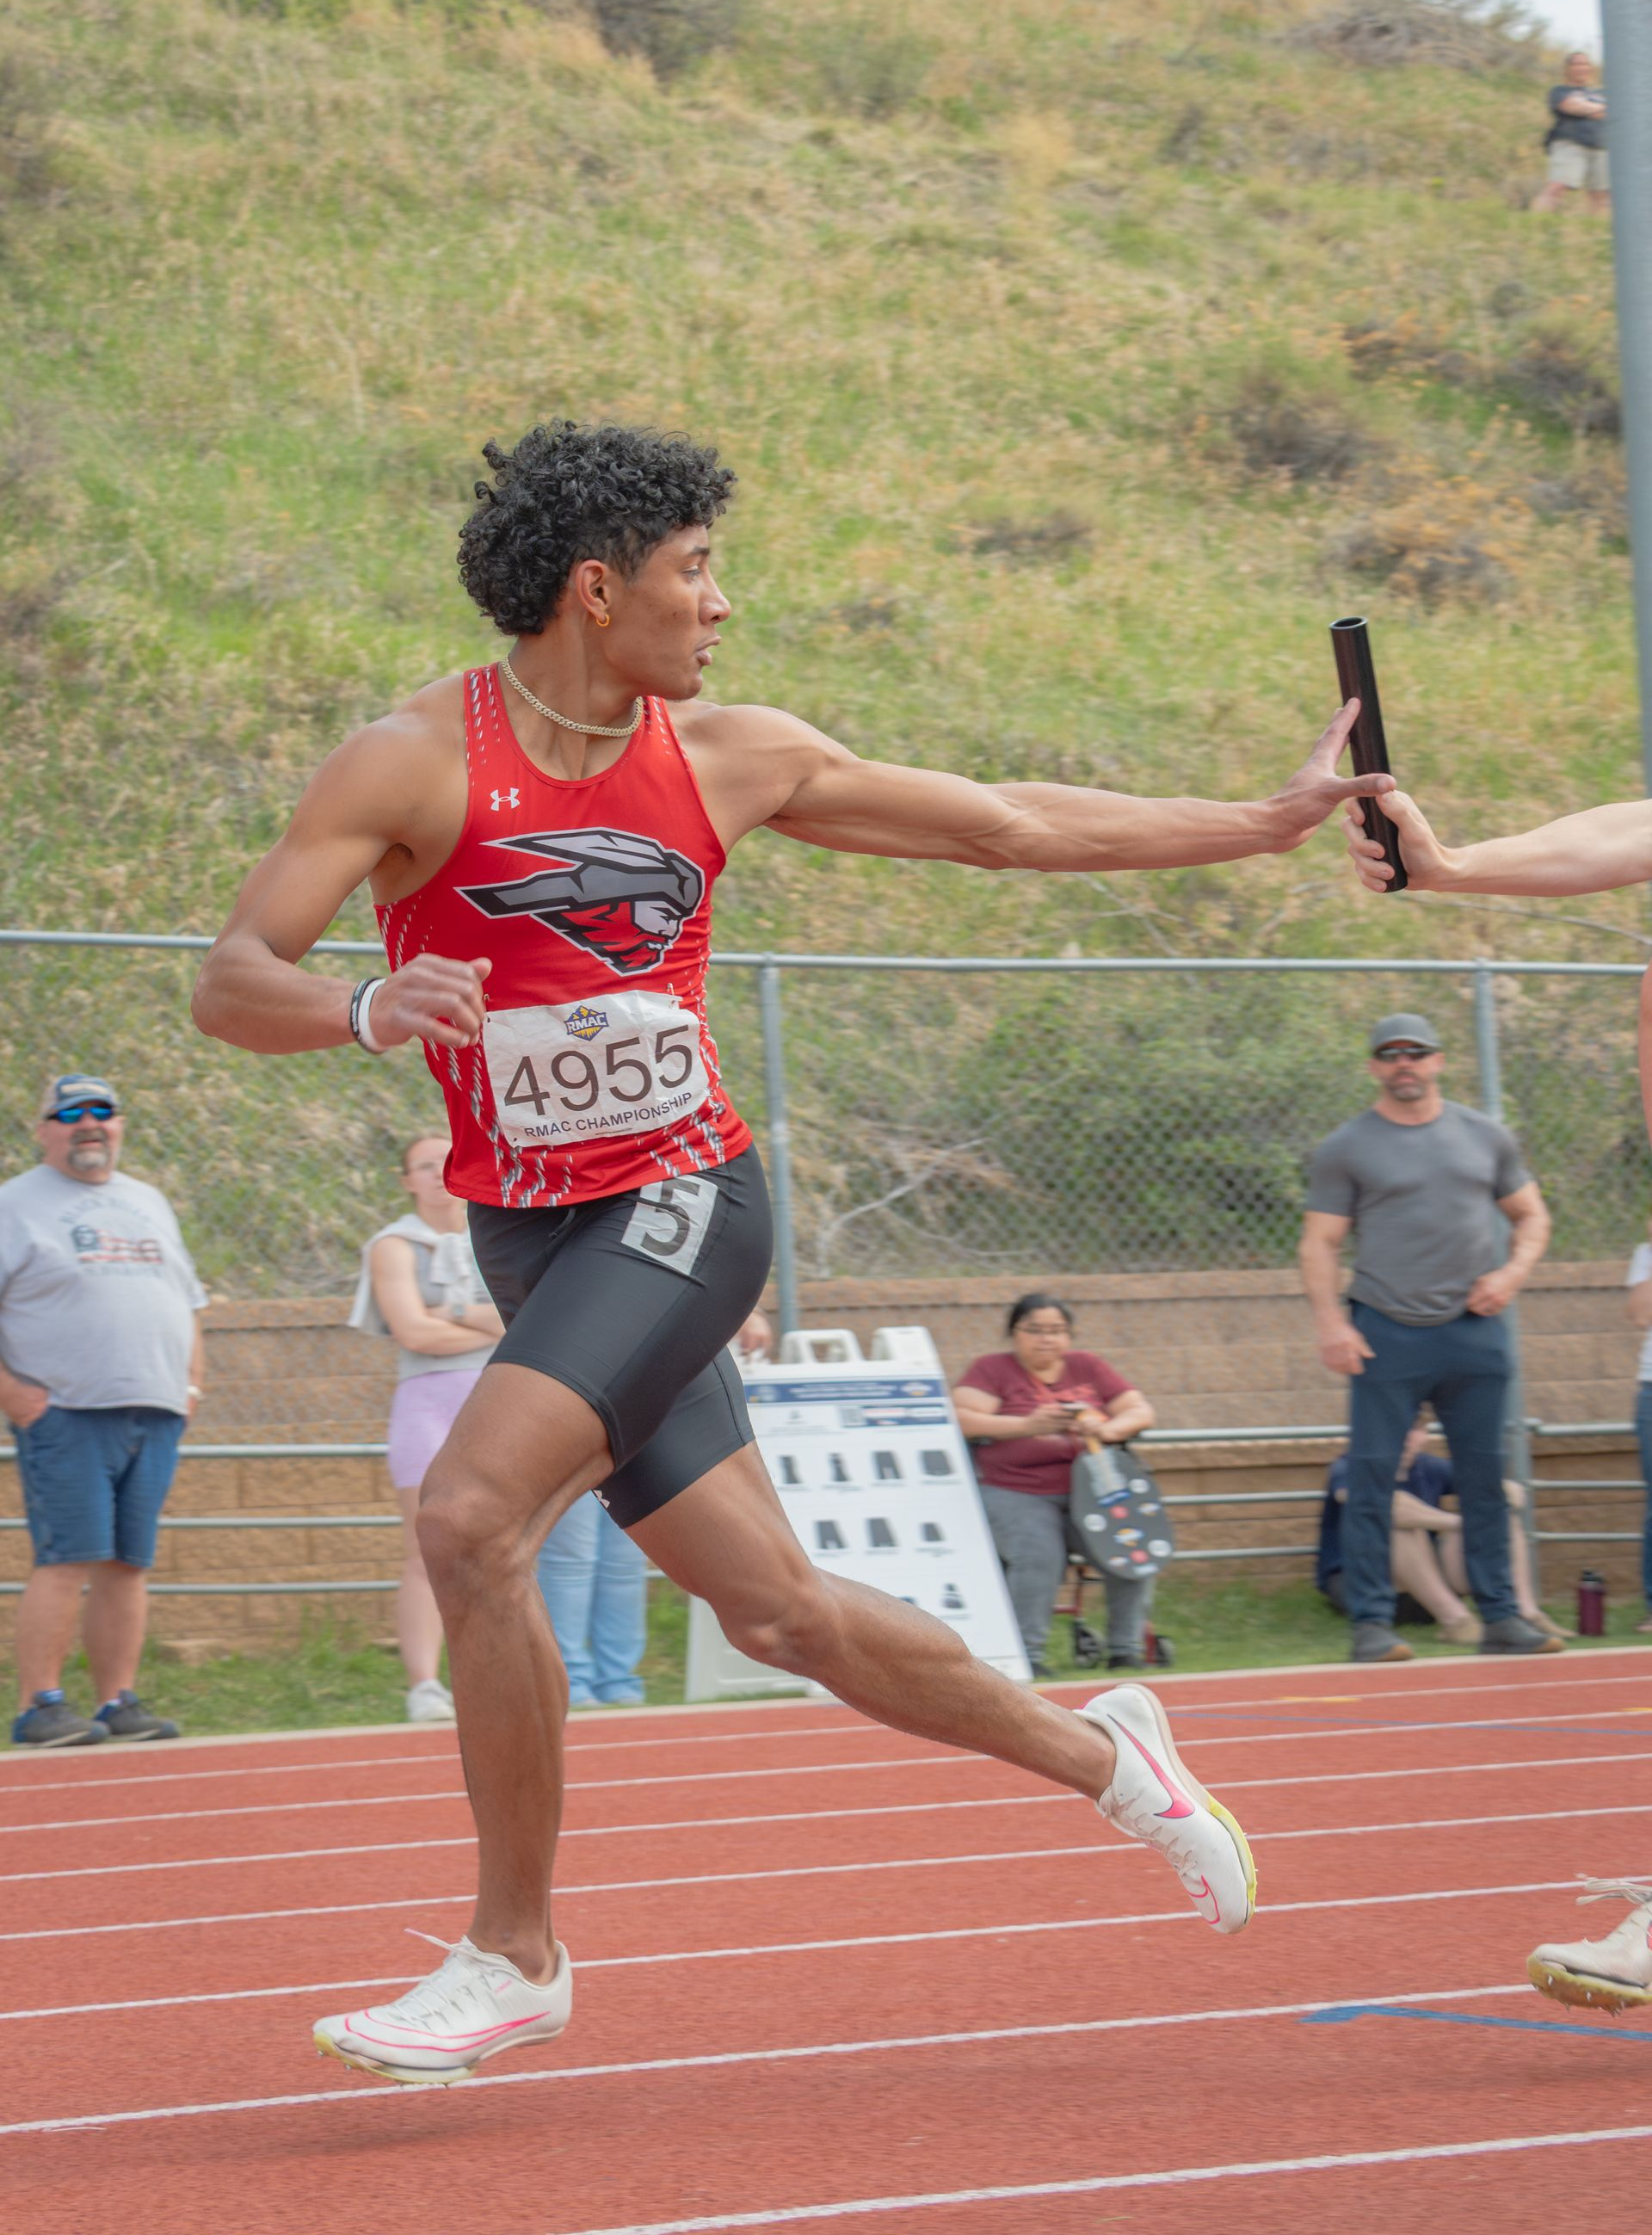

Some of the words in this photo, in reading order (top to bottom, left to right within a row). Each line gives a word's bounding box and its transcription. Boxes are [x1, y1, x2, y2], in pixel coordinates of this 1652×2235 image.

[565, 1014, 607, 1033] RMAC
[504, 1024, 693, 1115] 4955
[524, 1121, 571, 1138] RMAC
[576, 1092, 692, 1131] CHAMPIONSHIP
[640, 1178, 701, 1256] 5
